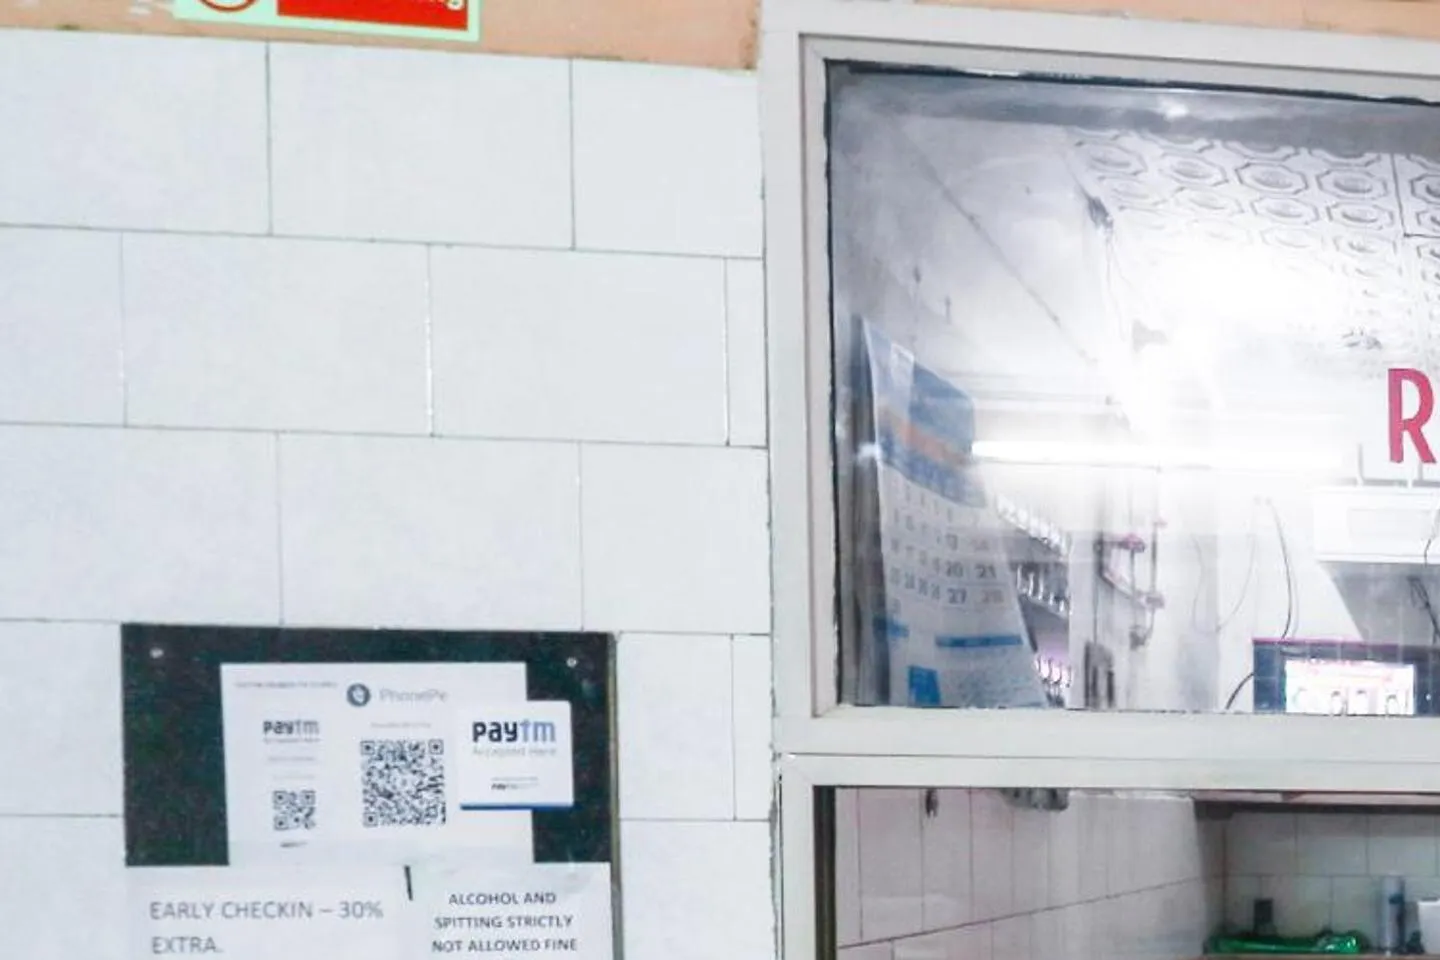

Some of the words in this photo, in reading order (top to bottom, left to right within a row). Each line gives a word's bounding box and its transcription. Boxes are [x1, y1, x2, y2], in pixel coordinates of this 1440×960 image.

[448, 893, 519, 905] ALCOHOL
[523, 892, 557, 904] AND
[150, 901, 214, 920] EARLY
[221, 900, 313, 919] CHECKIN
[338, 899, 384, 918] 30%
[434, 916, 503, 929] SPITTING
[506, 915, 574, 928] STRICTLY
[431, 940, 463, 952] NOT
[467, 939, 541, 951] ALLOWED
[544, 938, 577, 951] FINE
